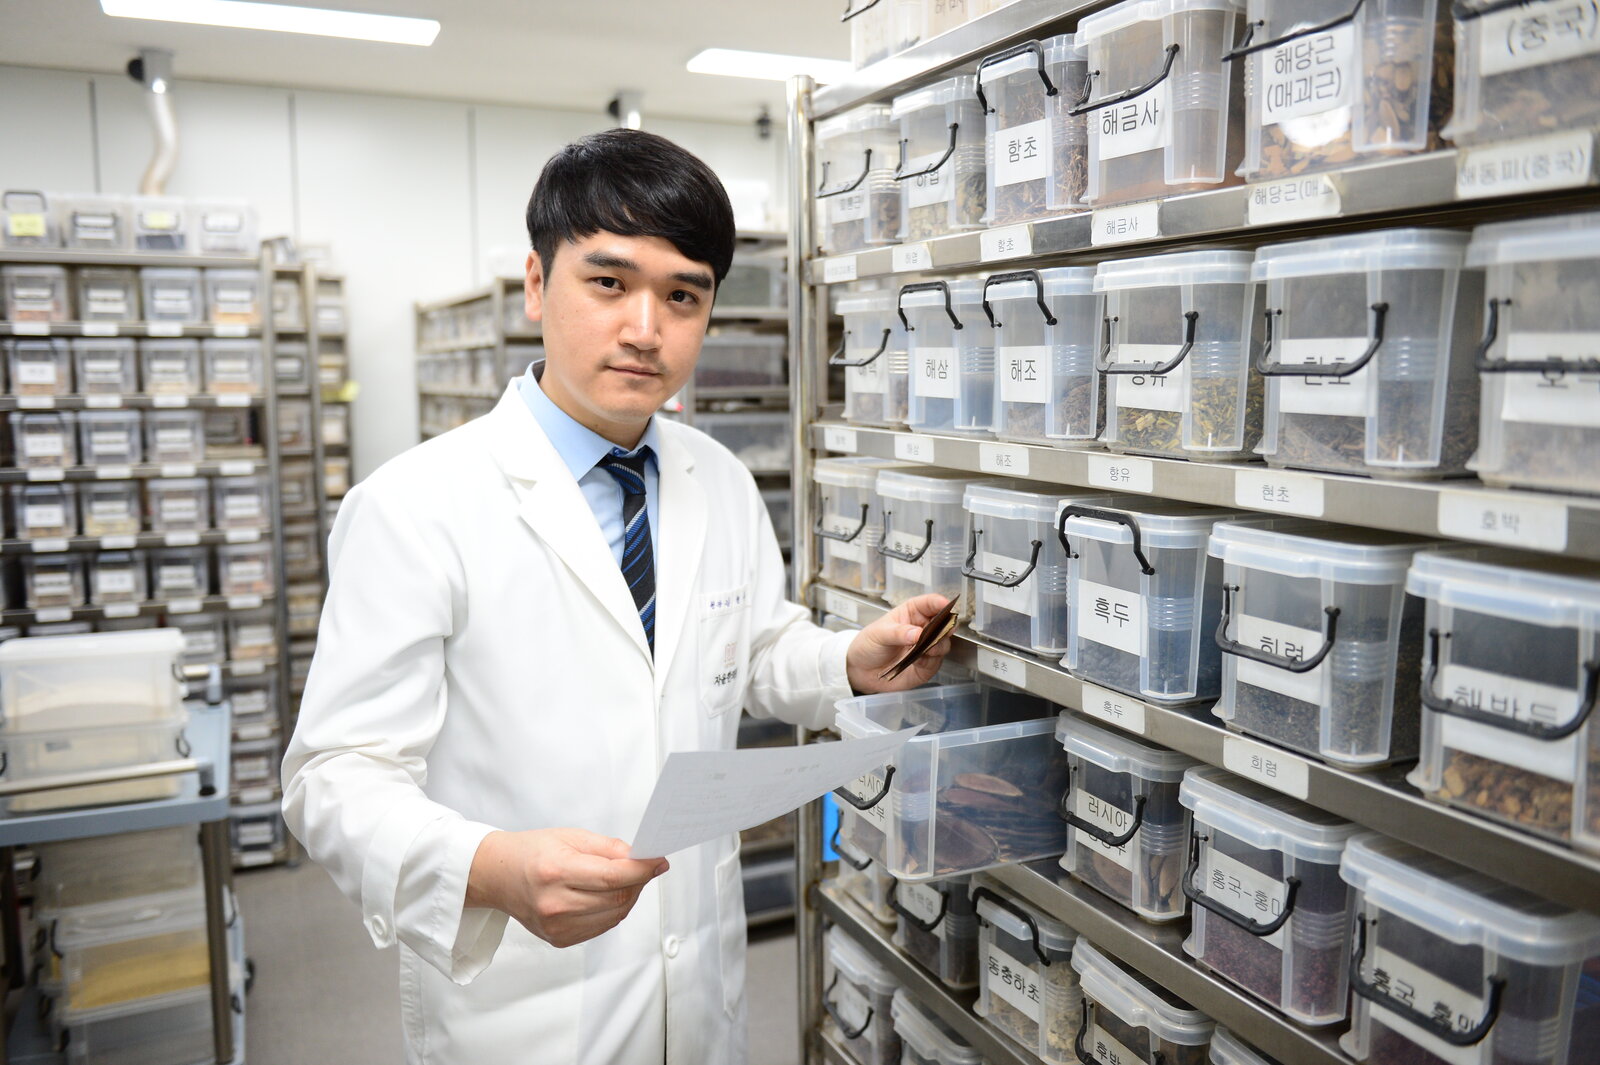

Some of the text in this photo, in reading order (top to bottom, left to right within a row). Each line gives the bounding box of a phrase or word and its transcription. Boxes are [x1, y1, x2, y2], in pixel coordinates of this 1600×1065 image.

[1274, 35, 1335, 75] 해당근
[1267, 66, 1342, 113] (매괴근)
[1102, 98, 1159, 136] 해금사
[1008, 136, 1037, 163] 함초
[1106, 216, 1139, 236] 해금사
[998, 238, 1014, 253] 함초
[925, 358, 949, 380] 해삼
[1010, 359, 1037, 382] 해조
[995, 453, 1012, 468] 해조
[1109, 466, 1130, 483] 향유
[1262, 484, 1290, 504] 현초
[1094, 597, 1130, 628] 흑두
[992, 658, 1008, 675] 후추
[1103, 700, 1123, 719] 흑두
[1251, 754, 1277, 778] 희렴
[1088, 795, 1128, 832] 러시아
[988, 955, 1040, 1004] 동충하초
